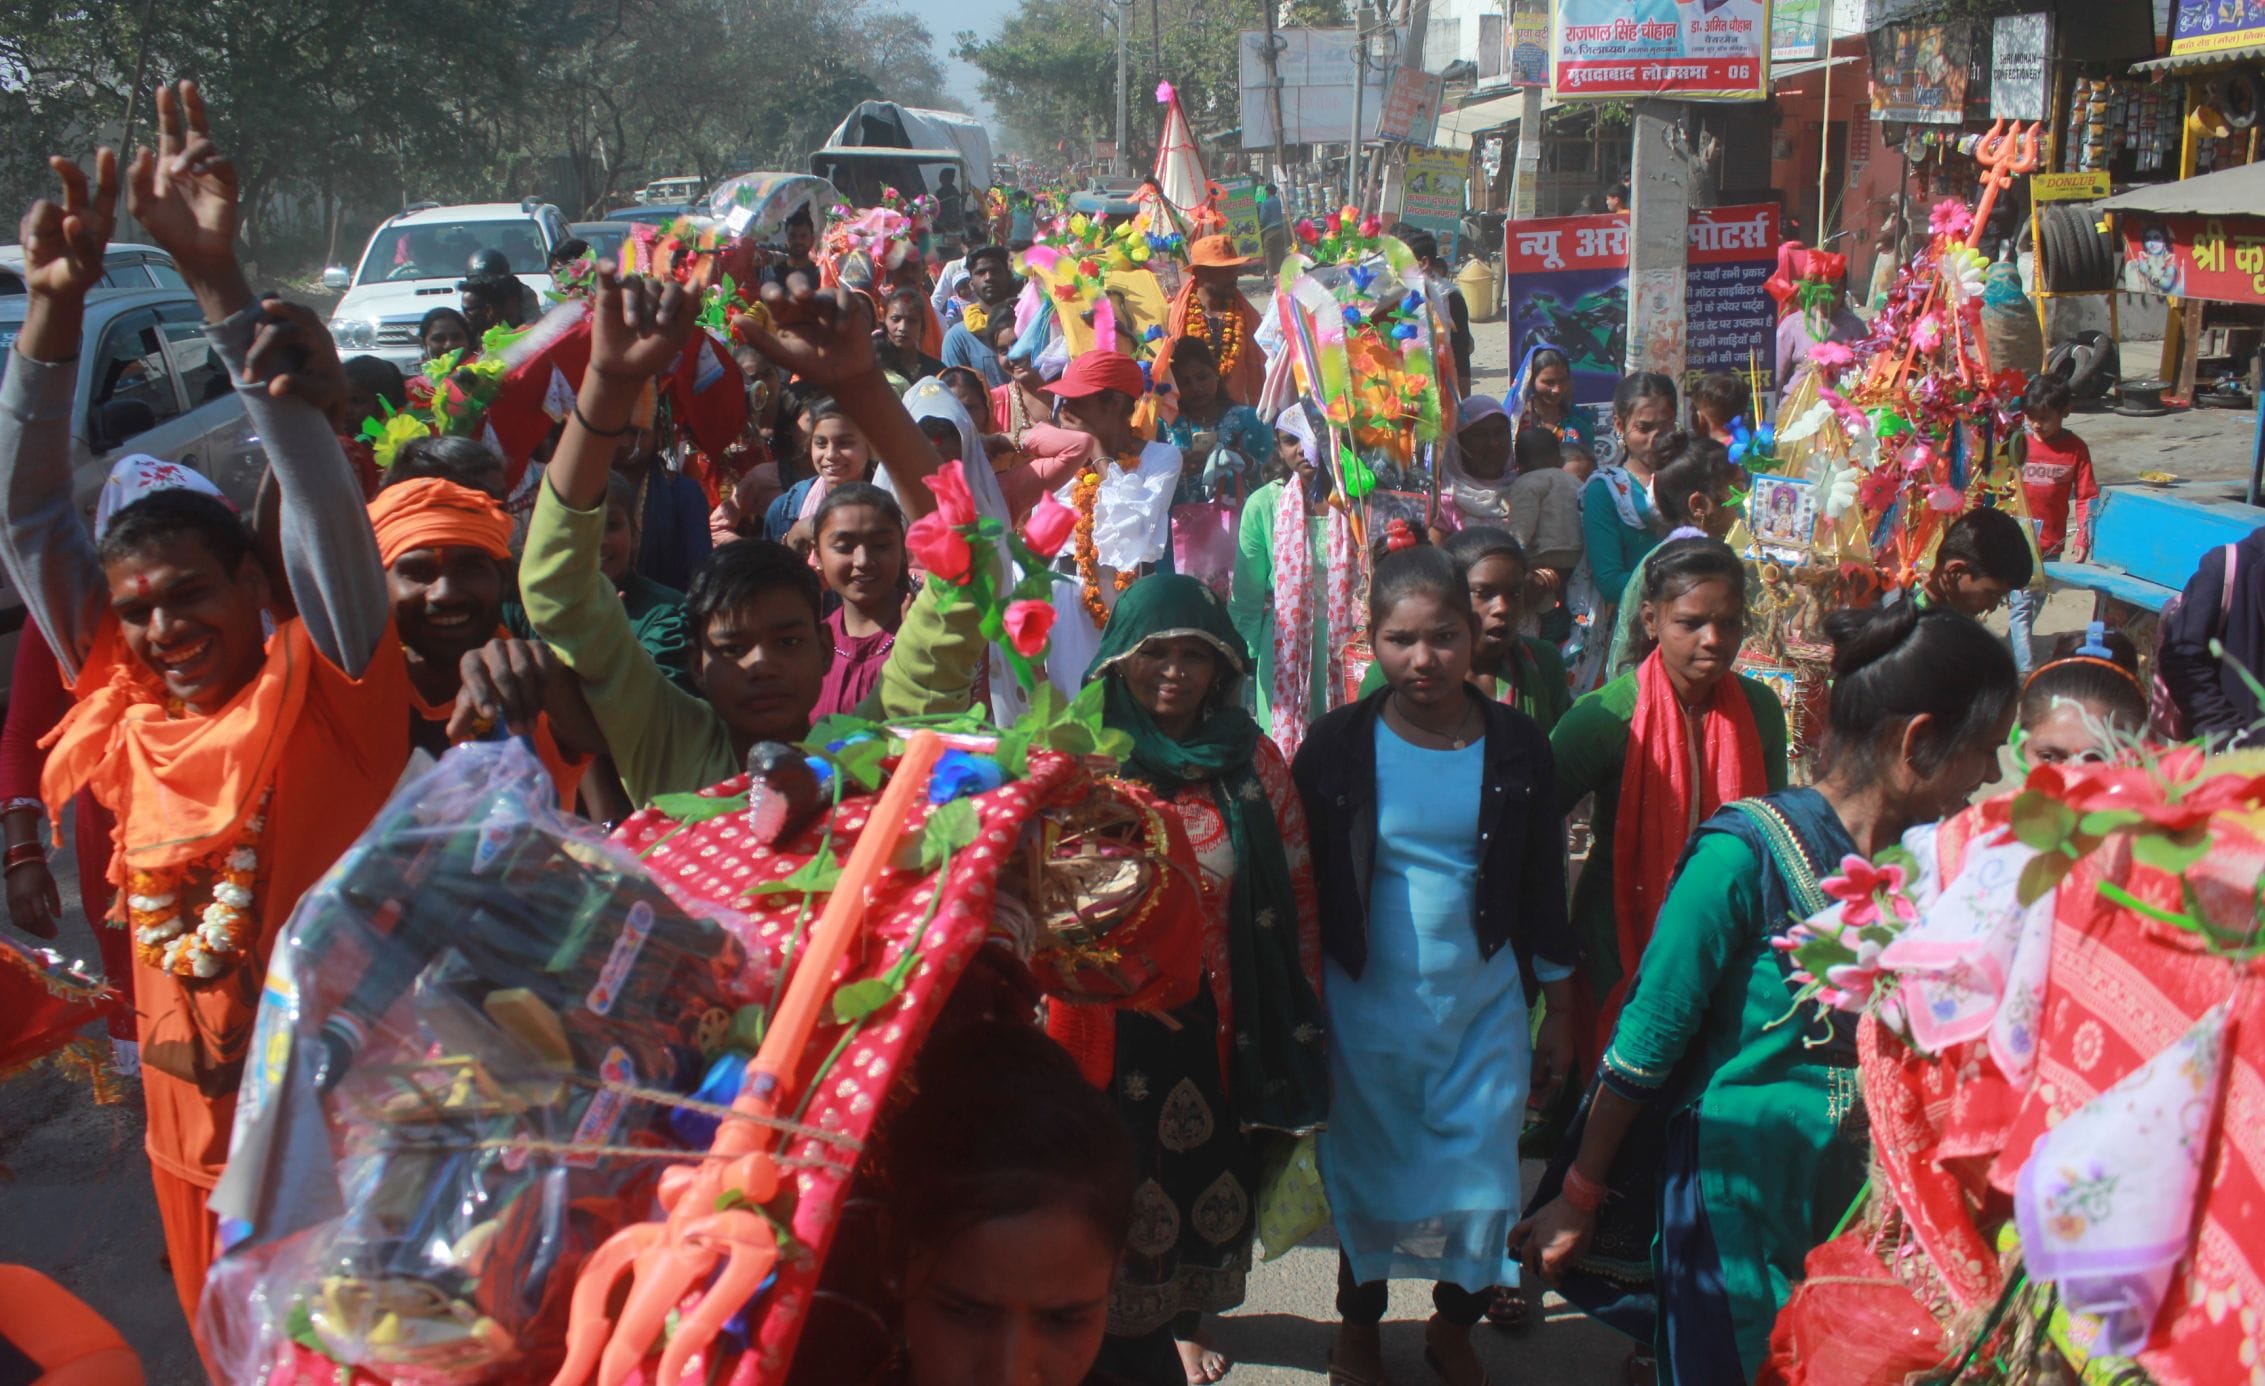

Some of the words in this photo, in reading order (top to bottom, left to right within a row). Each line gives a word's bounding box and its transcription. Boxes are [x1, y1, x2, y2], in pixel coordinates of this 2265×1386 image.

[1566, 25, 1611, 41] राजपाल
[1615, 18, 1638, 41] सिंह
[1705, 16, 1727, 32] अमित
[2243, 31, 2265, 41] निक
[2000, 53, 2013, 64] SHRI
[2014, 53, 2037, 64] MOHAN
[1567, 66, 1637, 87] मुरादाबाद
[1641, 62, 1709, 82] लोकसभा
[1728, 65, 1750, 79] 06
[1993, 68, 2042, 80] CONFECTIONERY
[2046, 176, 2096, 188] DONLUB
[1516, 230, 1565, 269] न्यू
[1576, 219, 1630, 257] अरो
[2192, 219, 2227, 272] श्री
[1687, 269, 1701, 280] मारे
[1703, 267, 1720, 280] यहाँ
[1722, 266, 1740, 279] सभी
[1742, 267, 1766, 280] प्रकार
[1695, 286, 1716, 297] मोटर
[1718, 283, 1755, 297] साइकिल
[1705, 301, 1714, 312] के
[1717, 299, 1740, 312] स्पेयर
[1707, 318, 1718, 330] रेट
[1720, 319, 1731, 328] पर
[1733, 318, 1764, 328] उपलब्ध
[1766, 313, 1773, 327] है
[1697, 334, 1716, 347] सभी
[1749, 332, 1762, 344] की
[1706, 351, 1717, 363] भी
[1720, 350, 1732, 362] की
